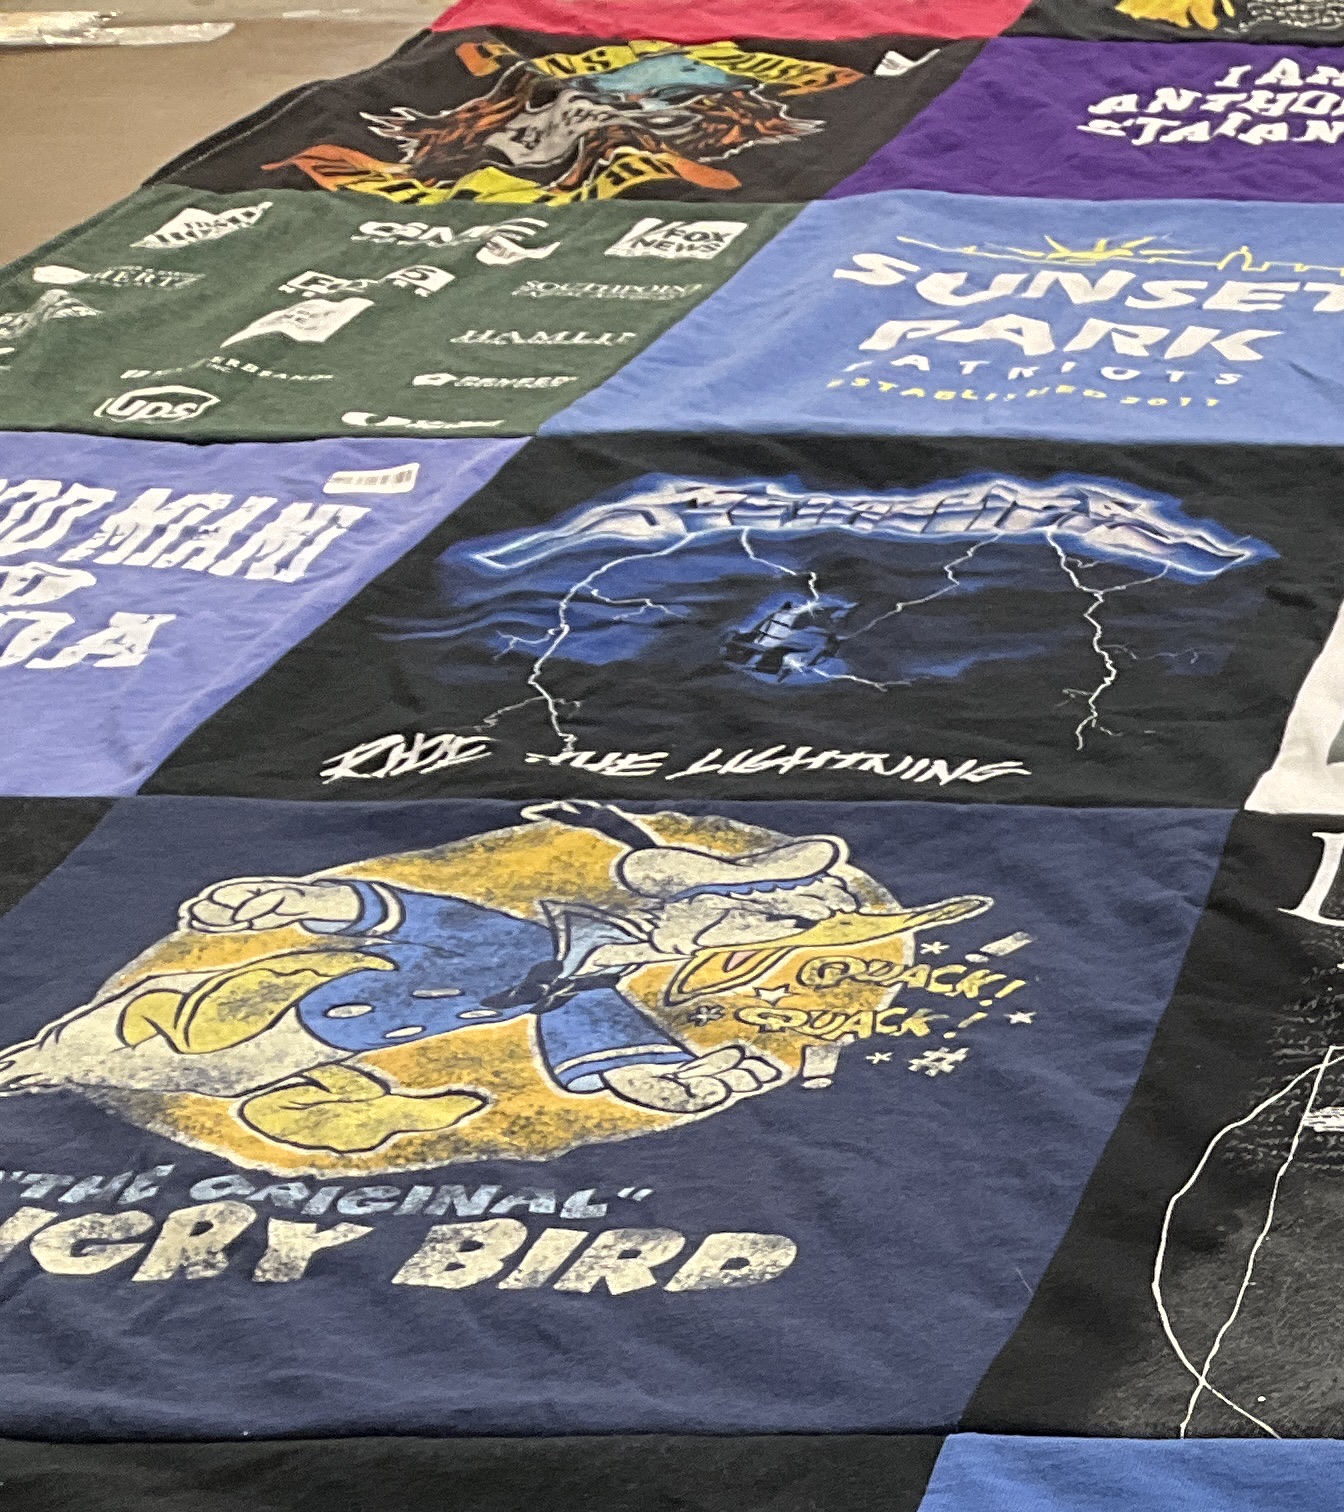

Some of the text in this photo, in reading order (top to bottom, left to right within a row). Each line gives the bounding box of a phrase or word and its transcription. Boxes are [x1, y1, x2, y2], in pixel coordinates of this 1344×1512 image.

[1215, 64, 1251, 88] I
[631, 237, 723, 251] NEWS
[664, 227, 731, 242] FOX
[858, 314, 1284, 361] PARK
[665, 743, 1032, 784] LIGHTNING
[391, 1218, 798, 1296] BIRD
